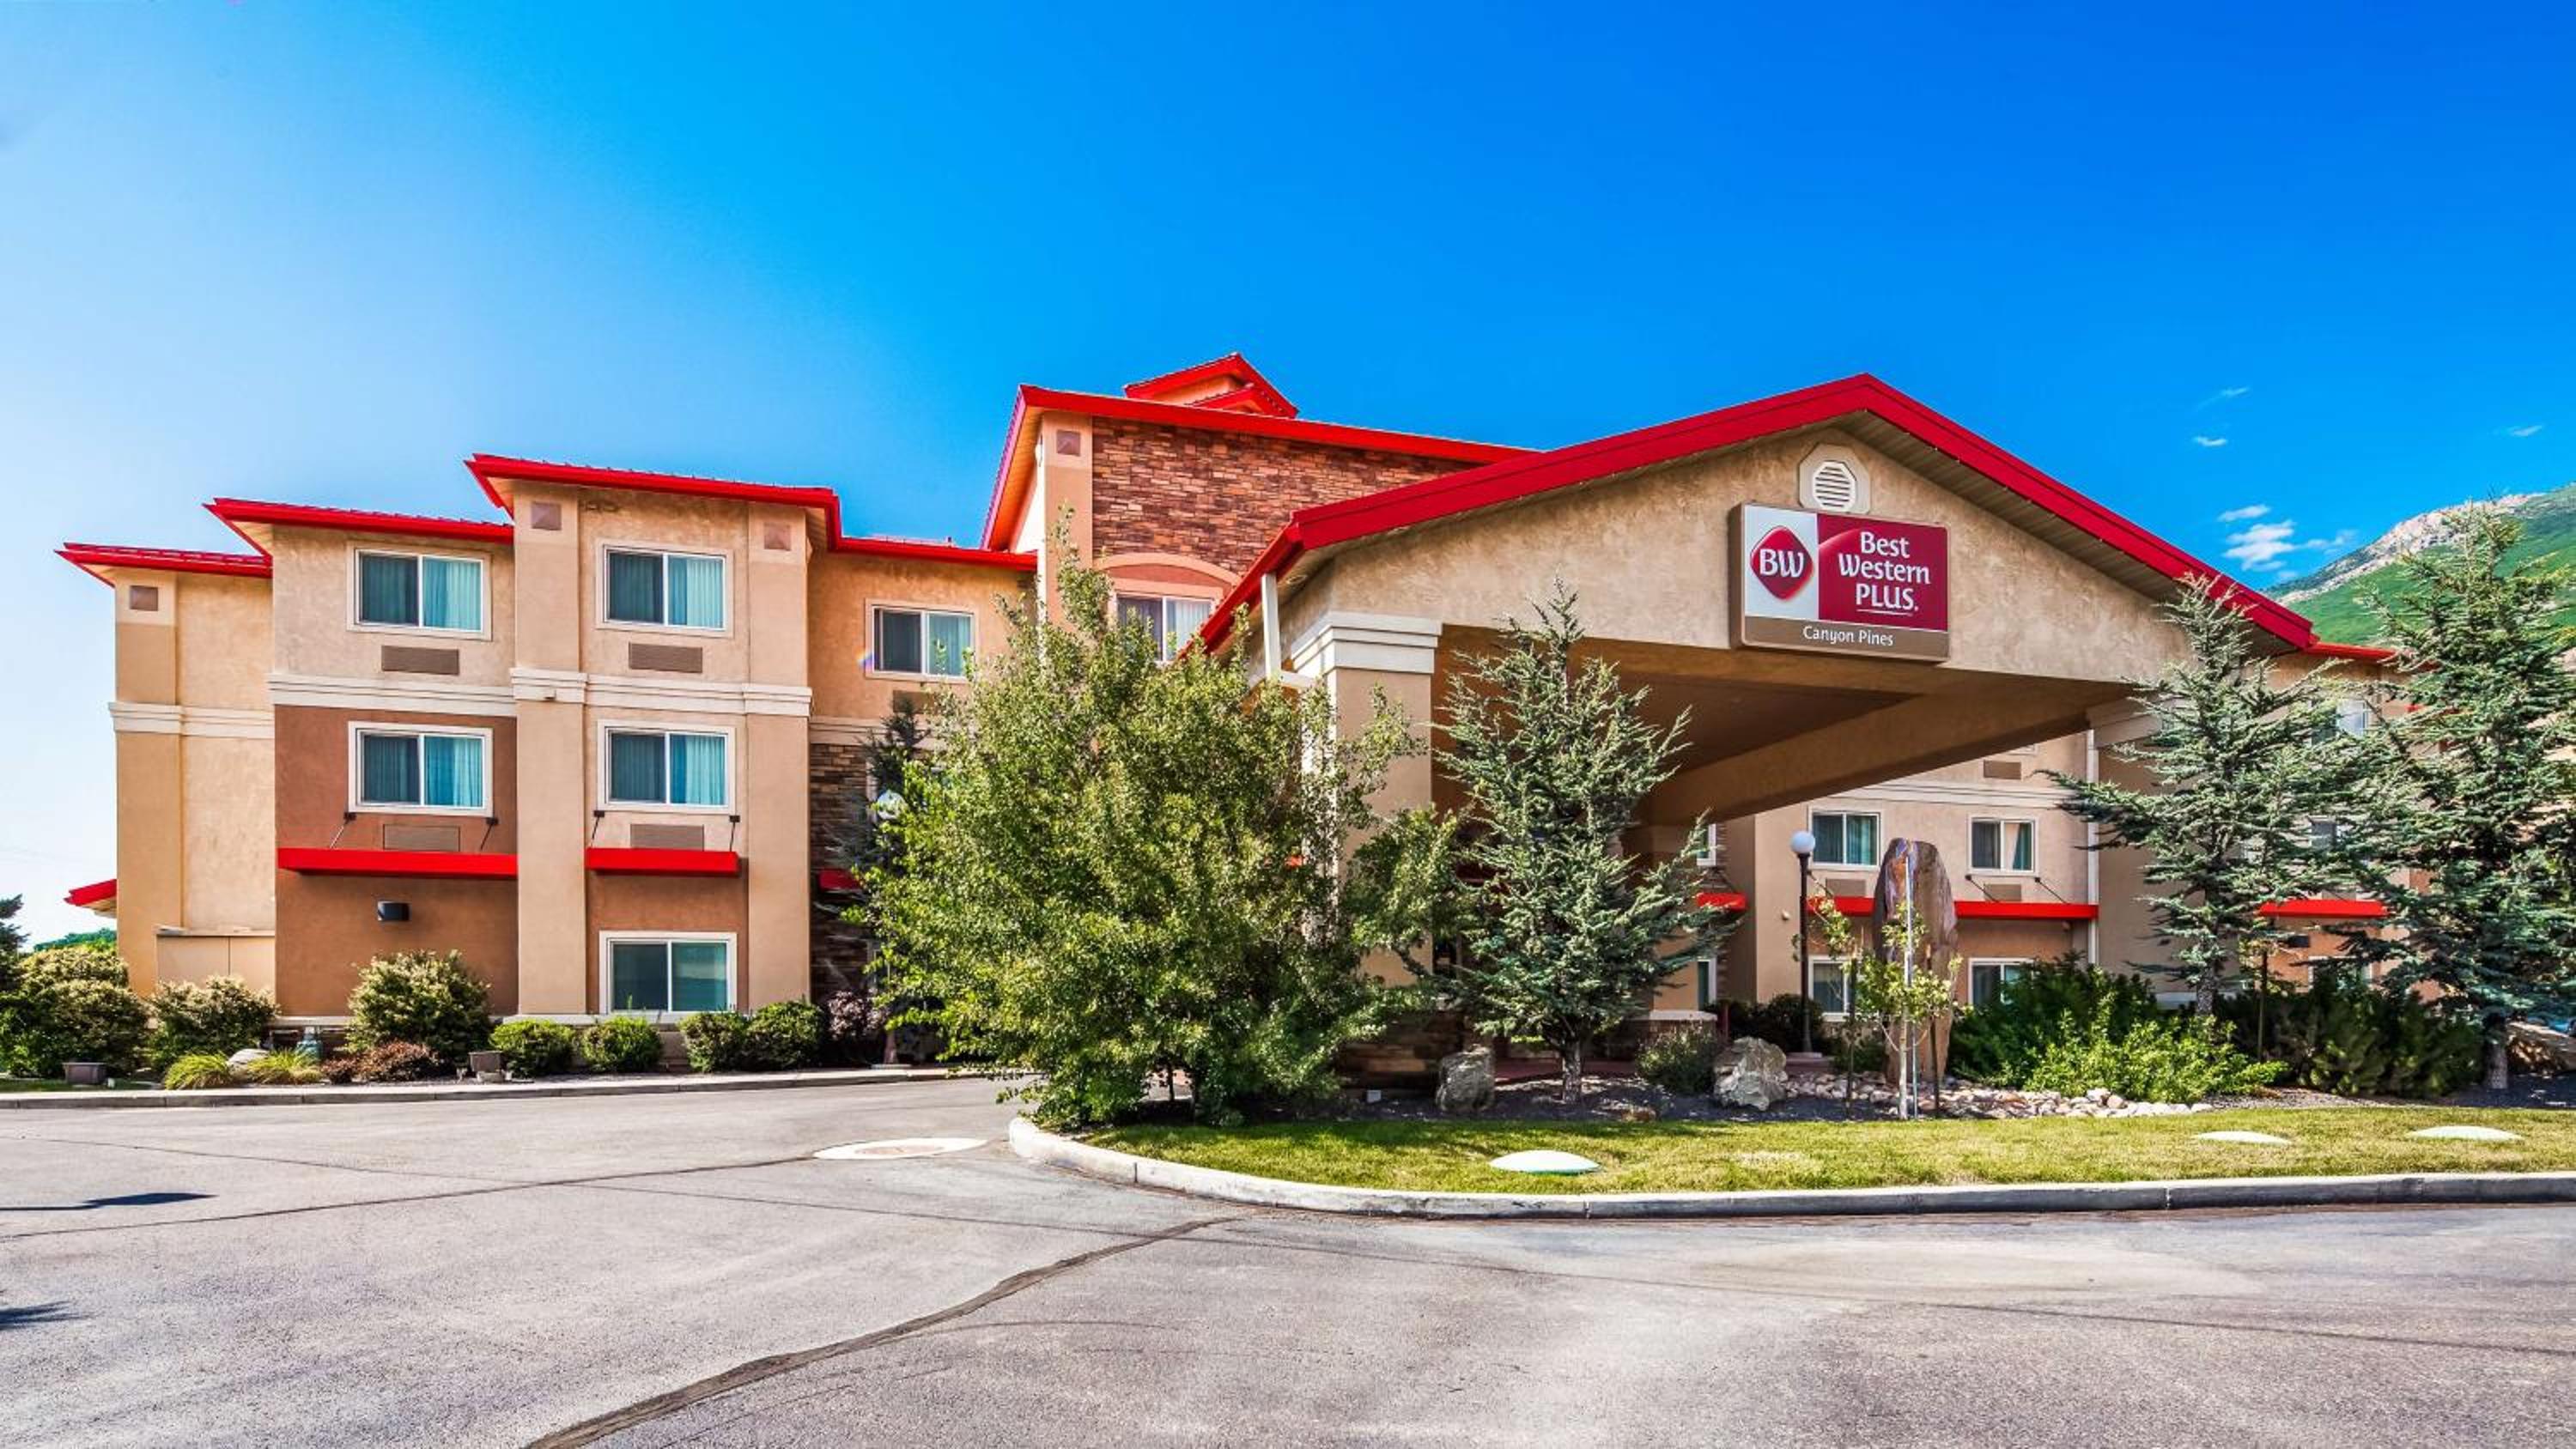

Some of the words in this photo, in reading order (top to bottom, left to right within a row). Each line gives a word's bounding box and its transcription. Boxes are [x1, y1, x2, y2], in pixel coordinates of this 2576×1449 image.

[1861, 531, 1911, 558] Best
[1759, 549, 1805, 578] BW
[1838, 553, 1931, 584] Western
[1802, 625, 1855, 645] Canyon
[1859, 630, 1894, 646] Pines
